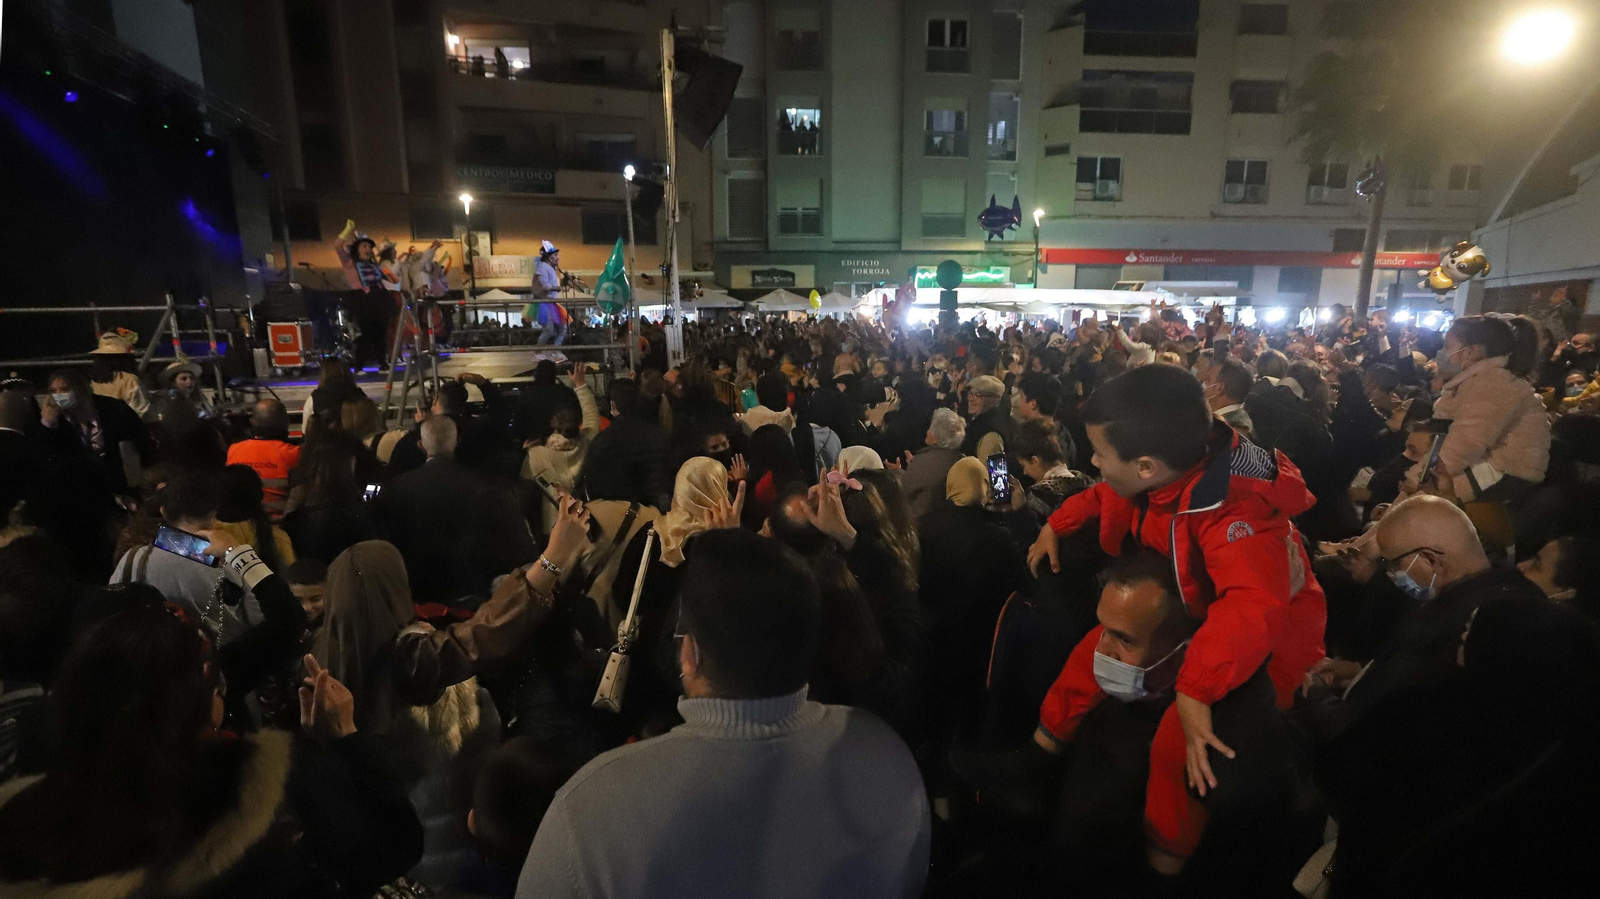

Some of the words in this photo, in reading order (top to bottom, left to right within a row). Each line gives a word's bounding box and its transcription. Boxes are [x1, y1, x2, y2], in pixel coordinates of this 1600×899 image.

[456, 167, 500, 178] CENTRO
[509, 169, 553, 180] MEDICO
[1139, 253, 1183, 263] Santander
